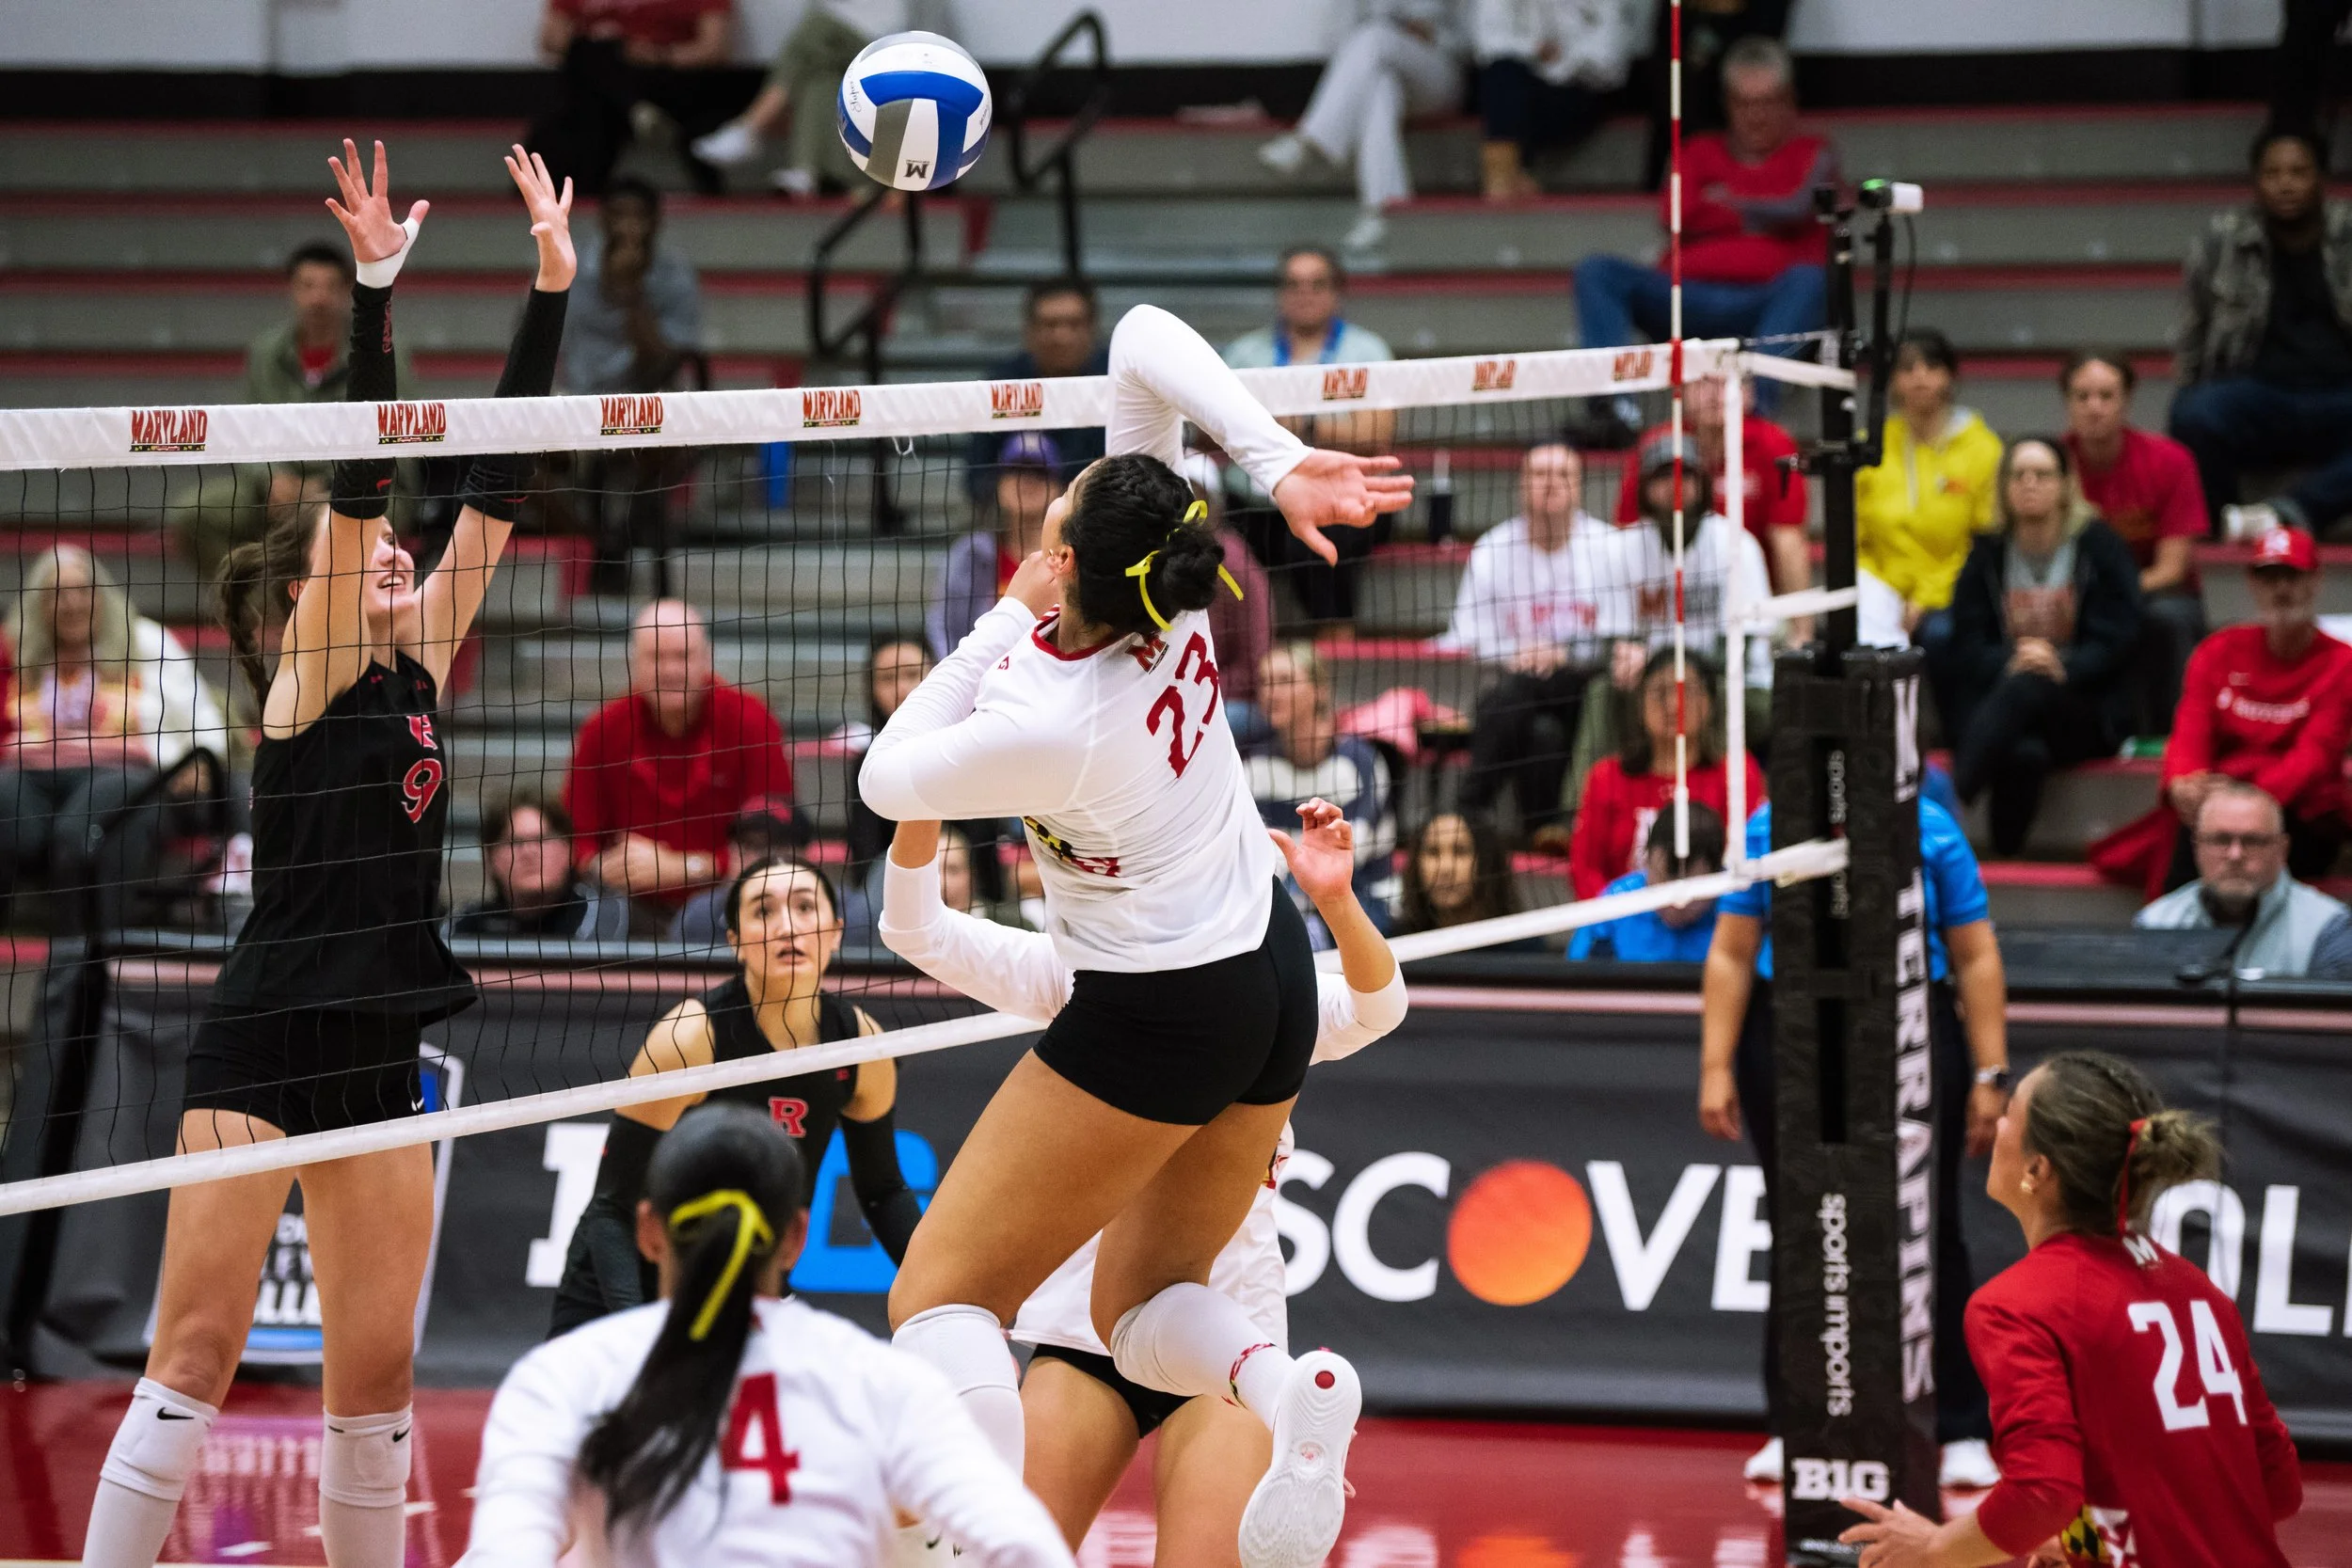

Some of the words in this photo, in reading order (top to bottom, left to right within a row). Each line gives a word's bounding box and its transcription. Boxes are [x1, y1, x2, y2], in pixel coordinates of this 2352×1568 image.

[132, 409, 208, 444] MARYLAND
[377, 402, 447, 436] MARYLAND
[600, 396, 663, 428] MARYLAND
[803, 389, 861, 420] MARYLAND
[1146, 630, 1219, 779] 23
[401, 757, 442, 824] 9
[769, 1096, 808, 1138] R
[1894, 867, 1933, 1402] TERRAPINS
[1272, 1148, 1772, 1312] SCOVE
[1817, 1193, 1851, 1293] sports
[2122, 1234, 2158, 1265] M
[1820, 1294, 1855, 1418] imports
[2127, 1300, 2249, 1433] 24
[722, 1371, 802, 1507] 4
